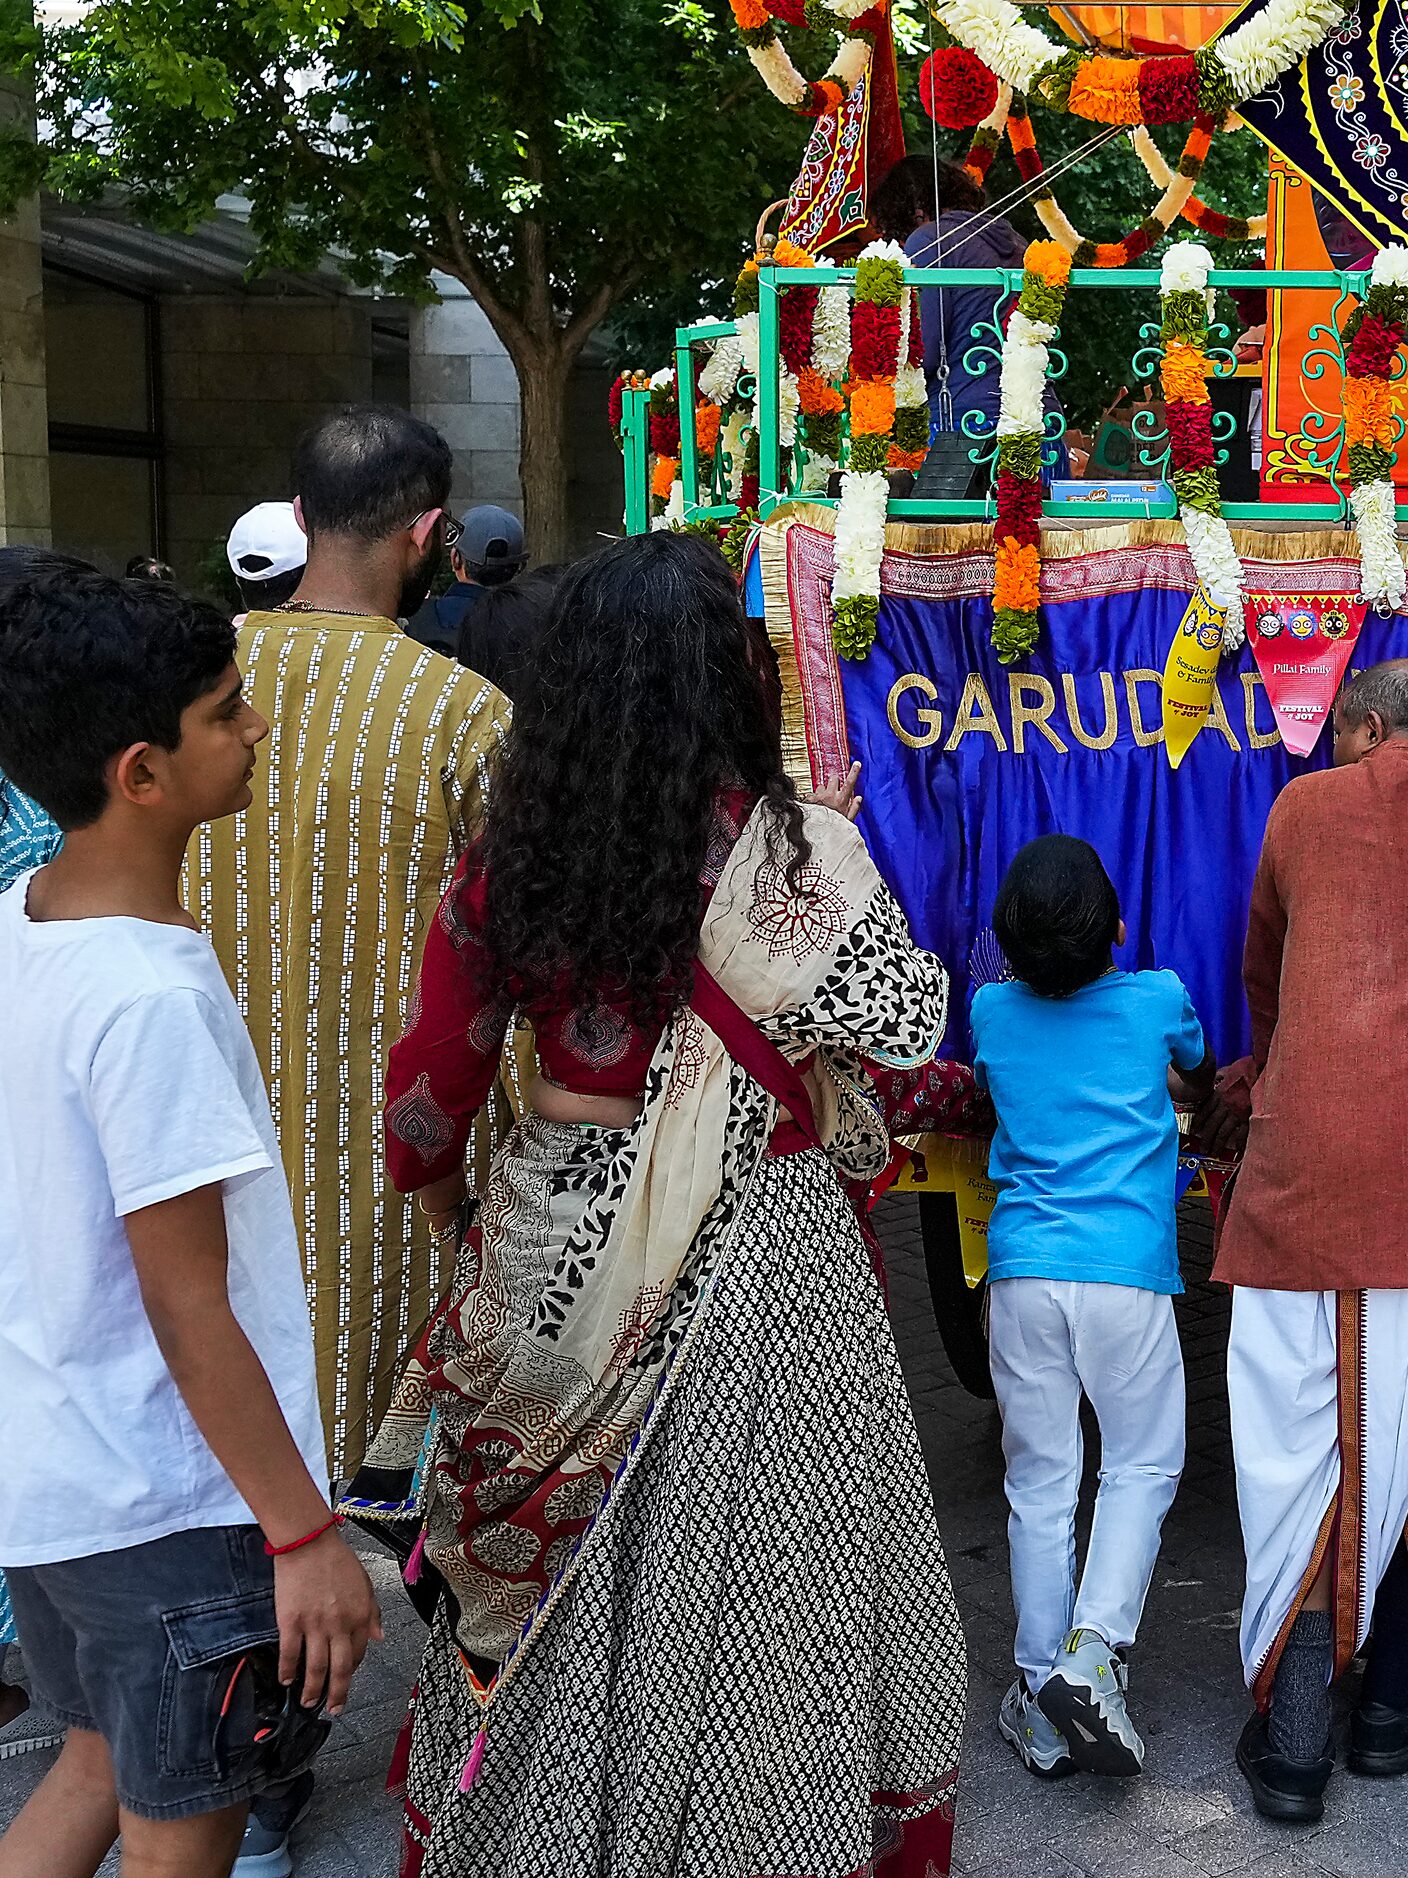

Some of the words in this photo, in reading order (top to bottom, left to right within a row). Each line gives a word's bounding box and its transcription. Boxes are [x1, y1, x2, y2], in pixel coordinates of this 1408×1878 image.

[1299, 664, 1331, 676] Family
[1167, 699, 1208, 712] FESTIVAL
[1279, 705, 1324, 713] FESTIVAL
[1181, 710, 1200, 718] JOY
